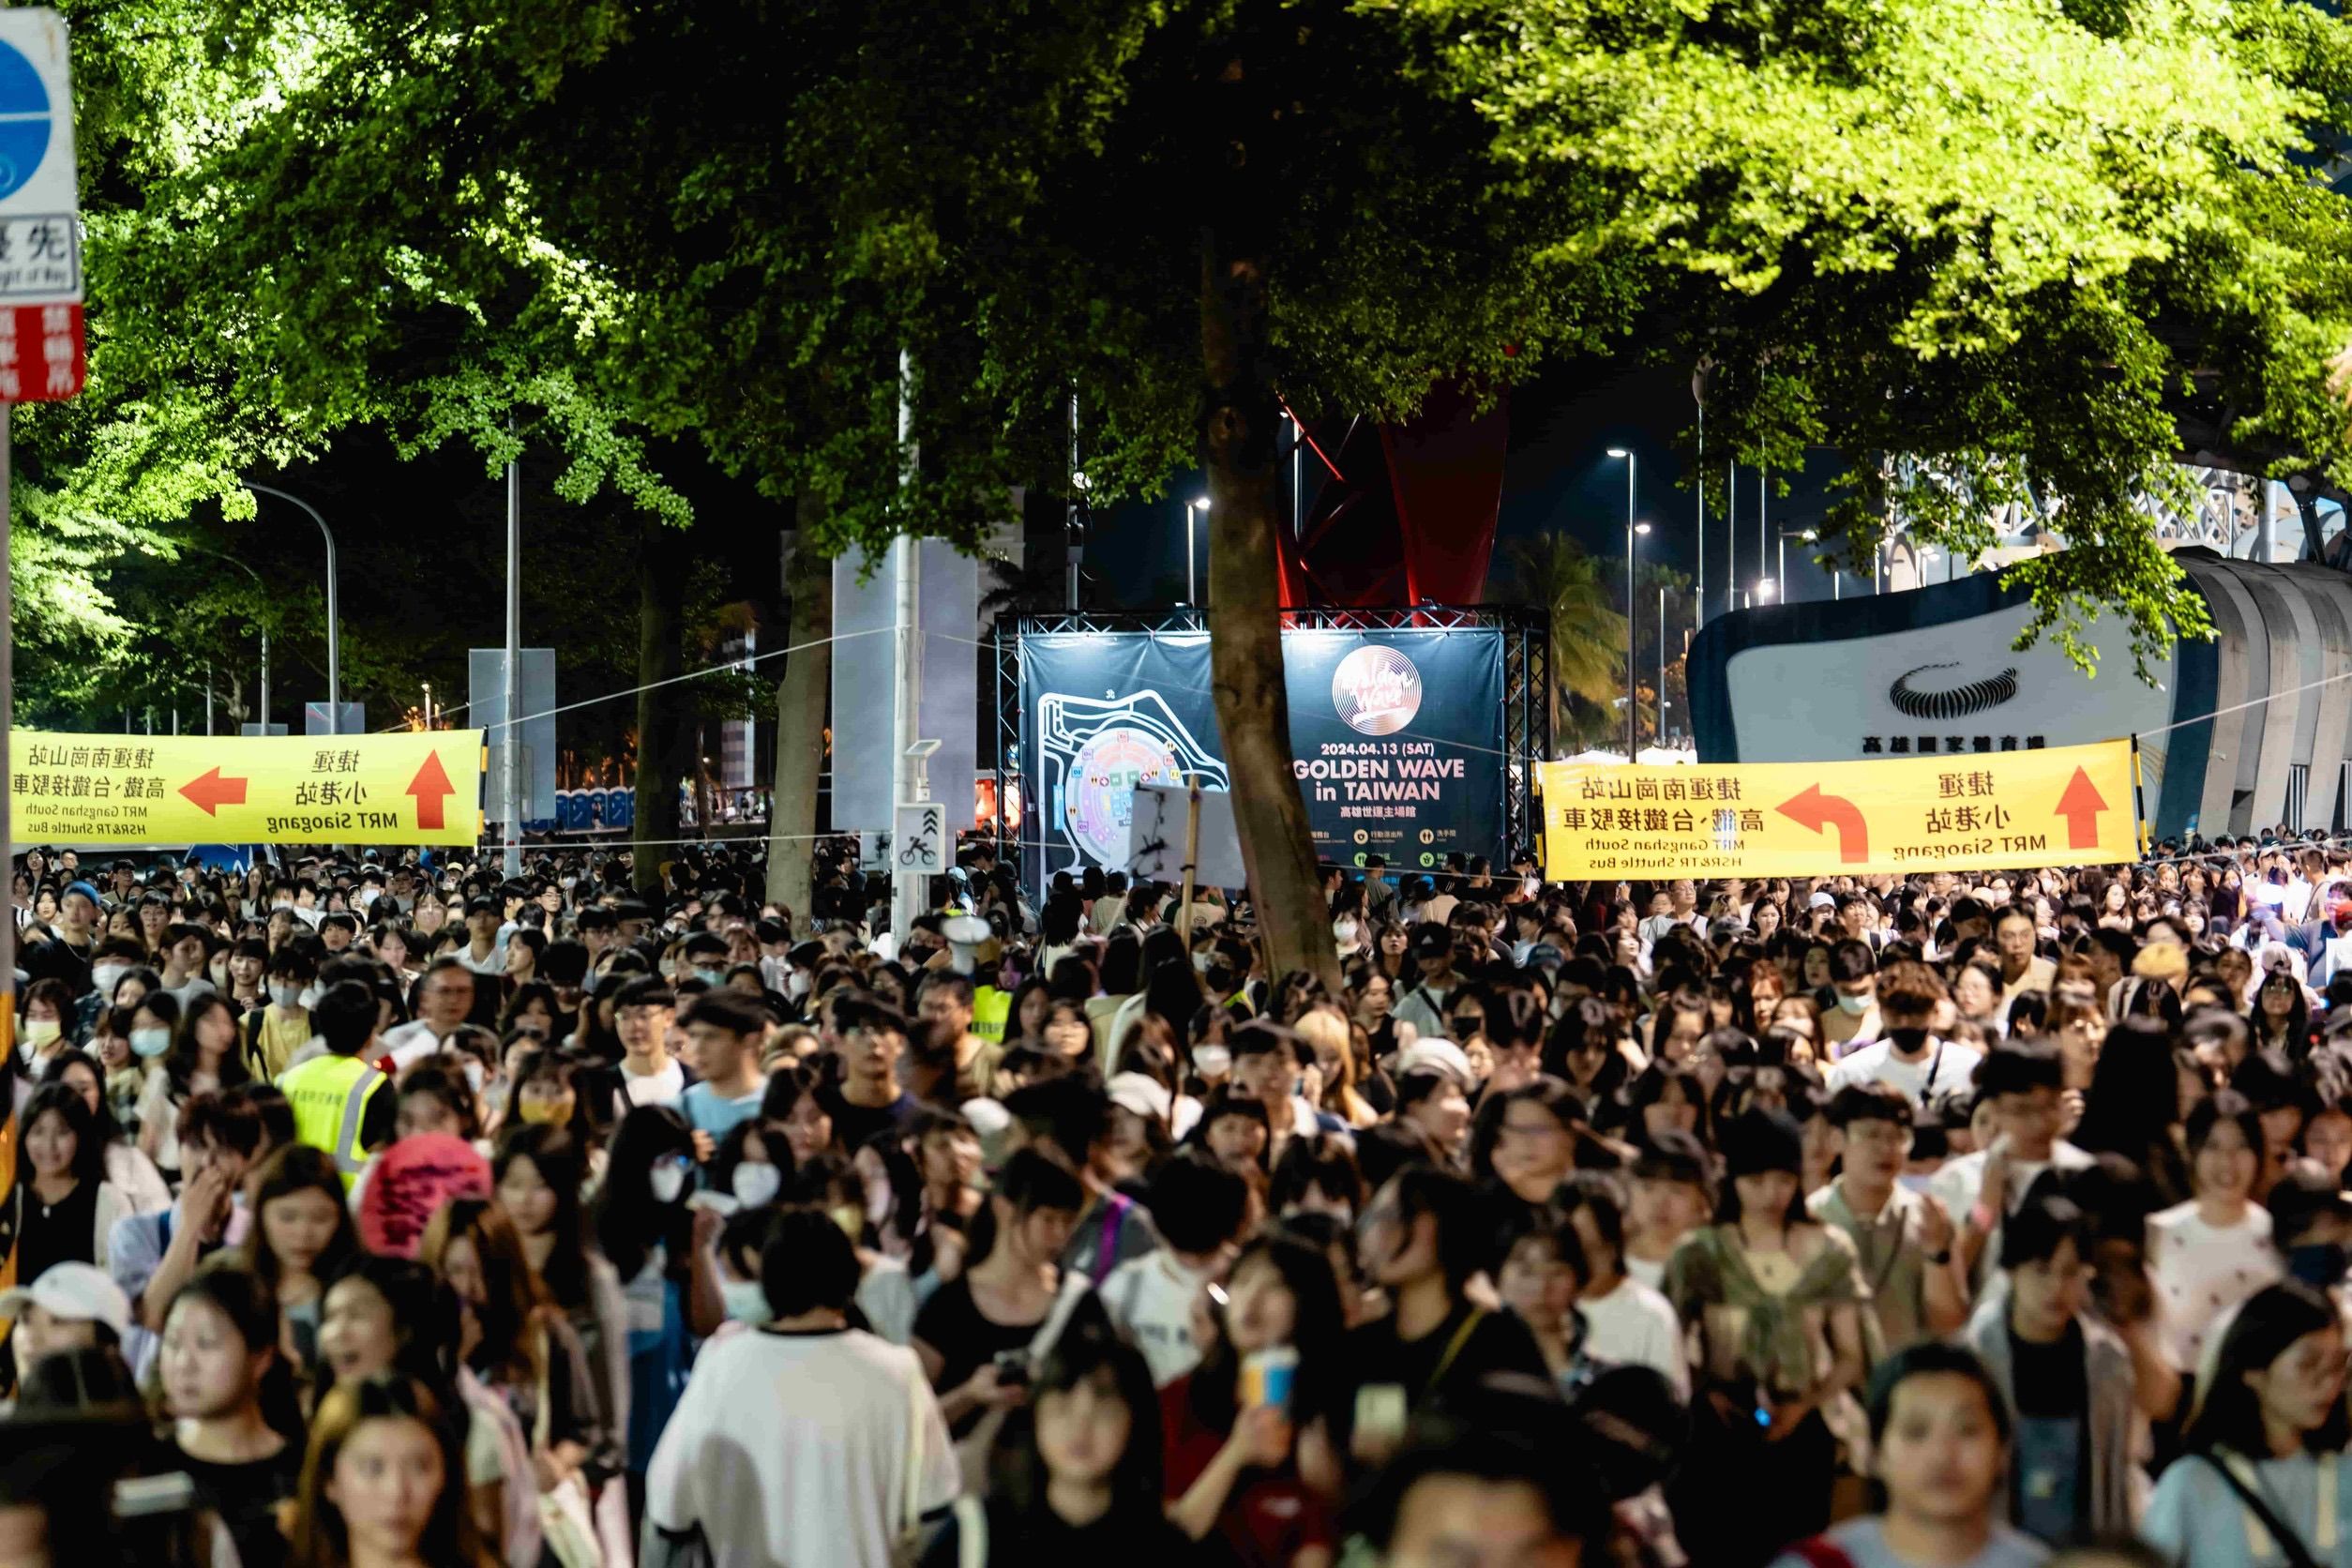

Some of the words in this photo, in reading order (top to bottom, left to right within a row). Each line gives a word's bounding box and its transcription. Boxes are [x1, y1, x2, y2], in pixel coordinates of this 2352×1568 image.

[1320, 743, 1398, 756] 2024.04.13
[1402, 743, 1435, 757] (SAT)
[1292, 759, 1389, 780] GOLDEN
[1395, 759, 1465, 779] WAVE
[1316, 780, 1337, 801] in
[1344, 781, 1440, 801] TAIWAN
